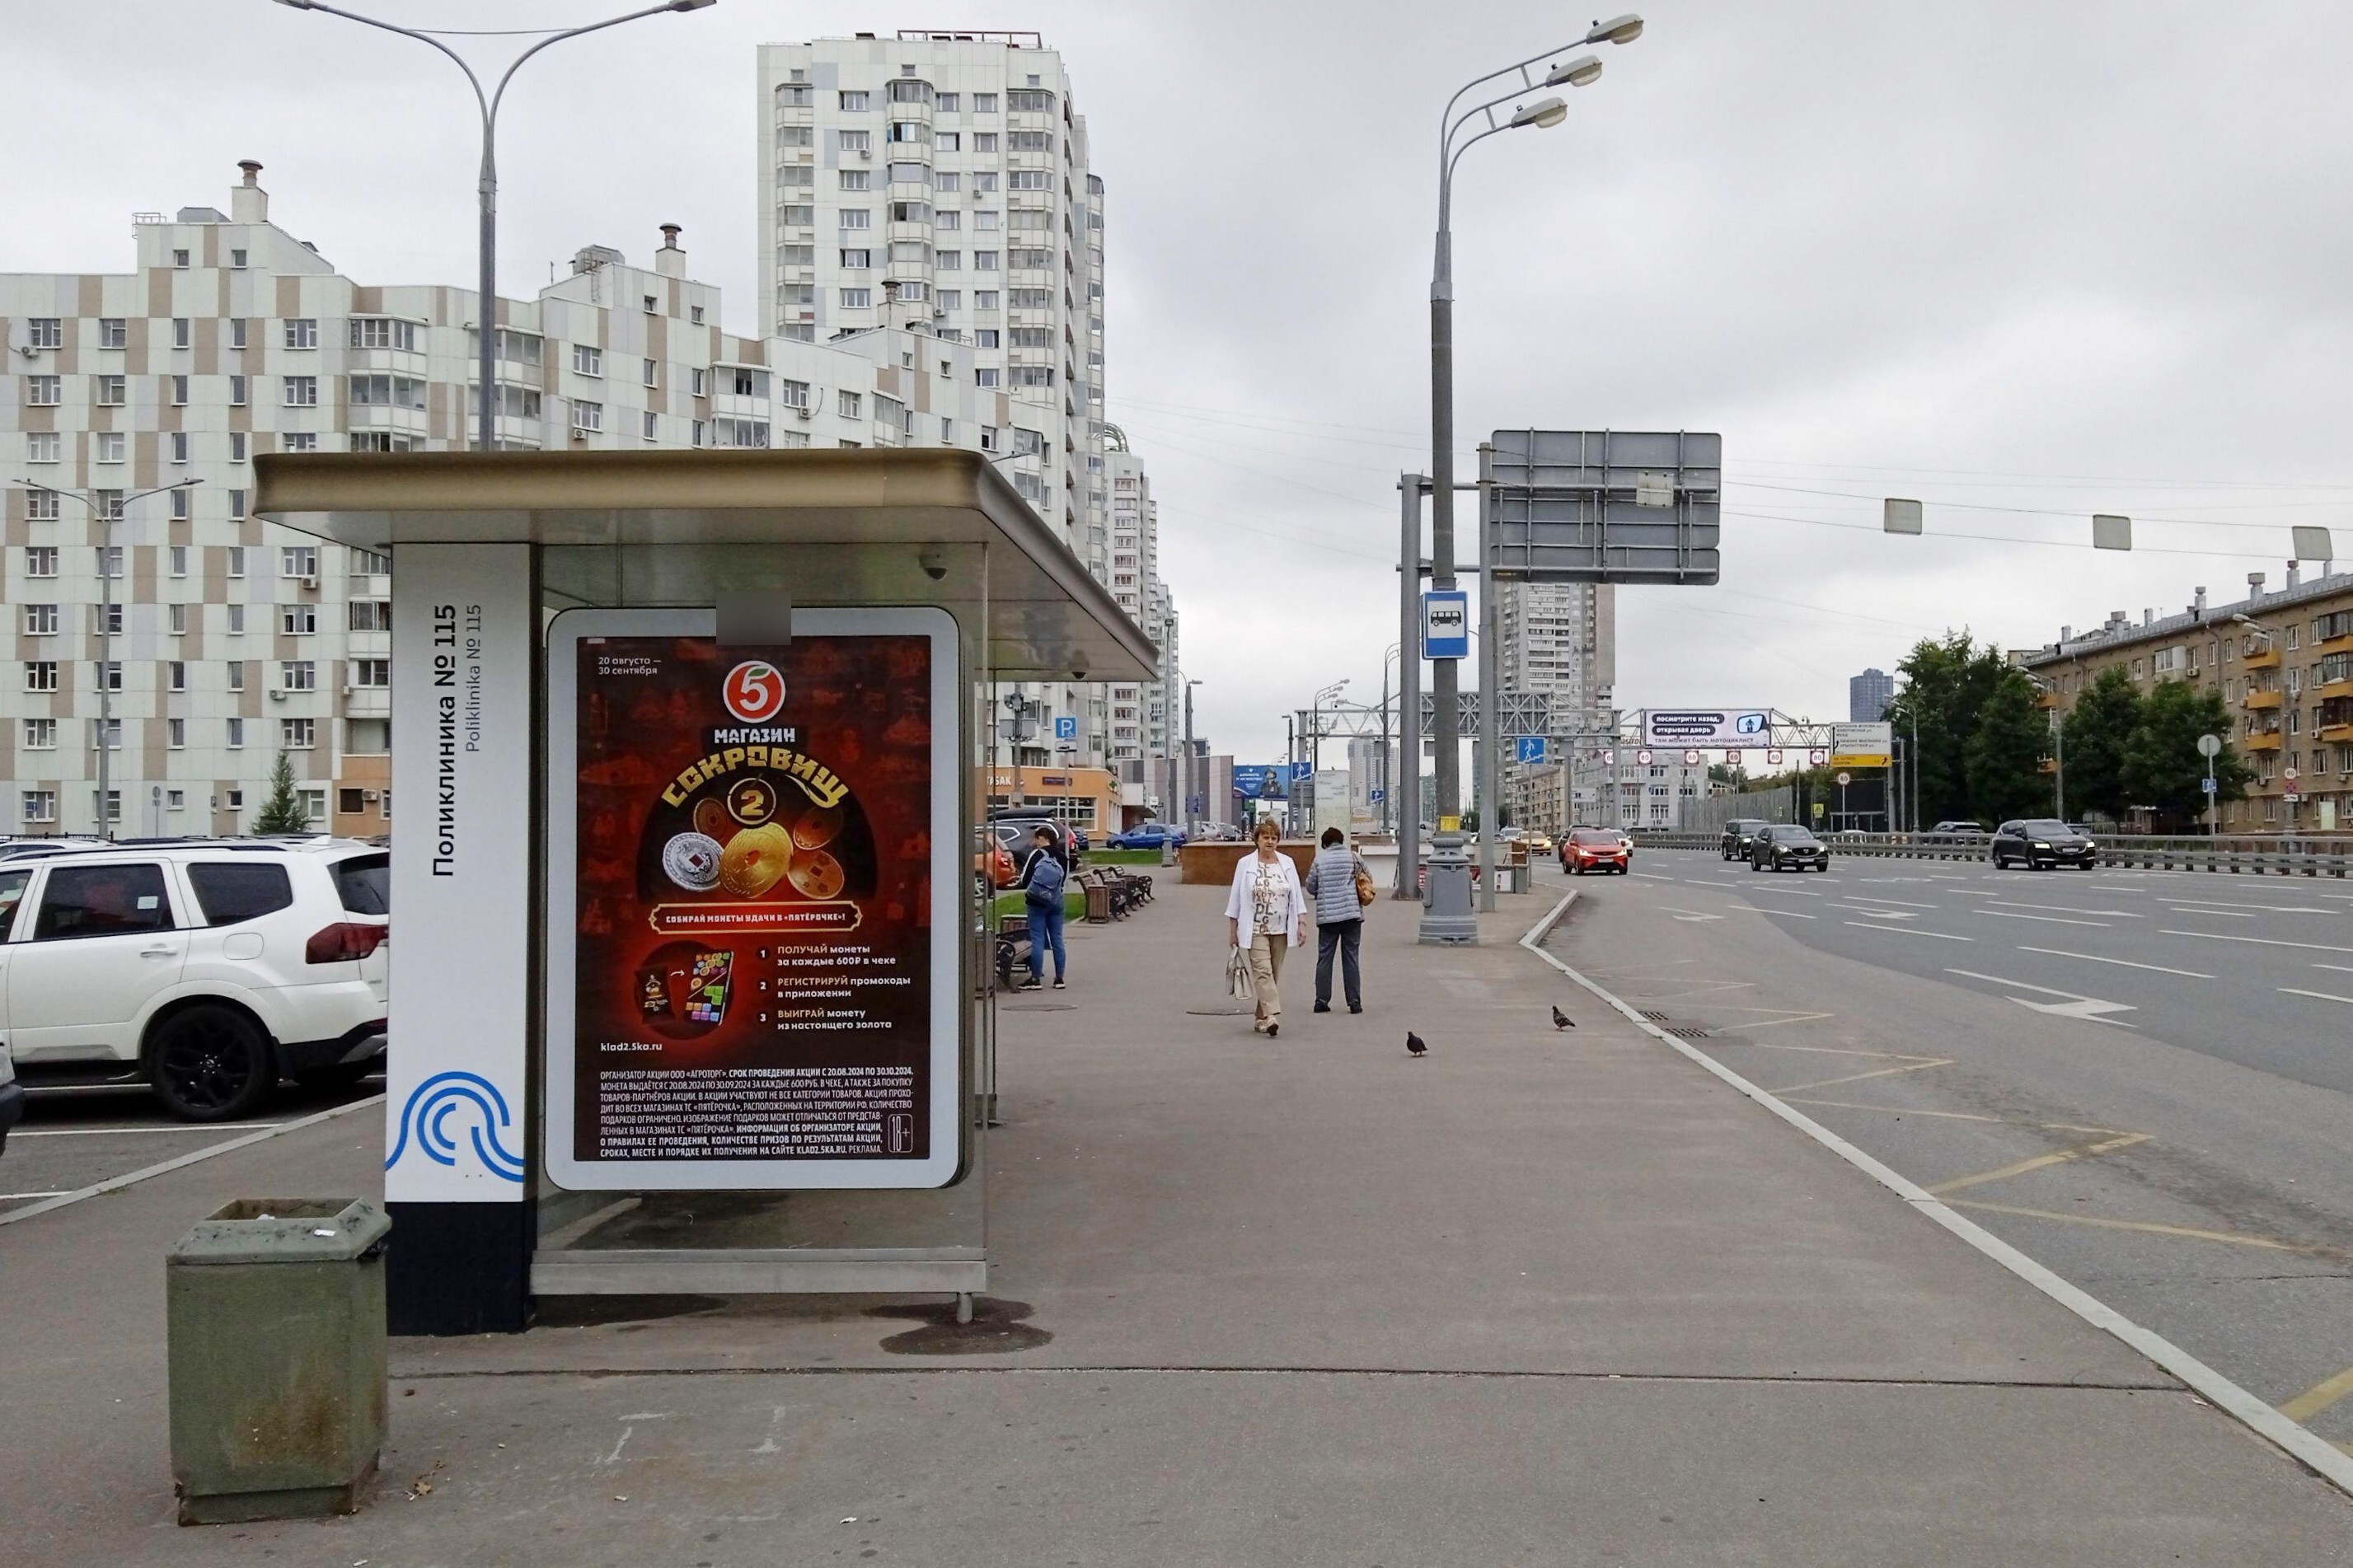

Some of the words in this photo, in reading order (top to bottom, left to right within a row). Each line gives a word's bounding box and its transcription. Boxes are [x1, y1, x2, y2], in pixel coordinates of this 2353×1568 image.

[466, 605, 481, 632] 115
[434, 605, 456, 647] 115
[466, 638, 480, 658] №
[598, 657, 610, 665] 20
[612, 658, 650, 667] августа
[434, 654, 456, 686] №
[598, 667, 610, 675] 30
[612, 666, 658, 676] сентября
[466, 665, 480, 751] Poliklinika
[714, 728, 795, 743] МАГАЗИН
[661, 746, 849, 808] СОКРОВИЩ
[433, 695, 456, 877] Поликлиника
[740, 789, 765, 816] 2
[666, 914, 705, 923] СОБИРАЙ
[707, 915, 743, 923] МОНЕТЫ
[745, 915, 776, 923] УДАЧИ
[760, 949, 766, 958] 1
[777, 943, 827, 954] ПОЛУЧАЙ
[829, 945, 870, 953] монеты
[792, 957, 834, 967] каждые
[760, 981, 766, 990] 2
[777, 975, 848, 986] РЕГИСТРИРУЙ
[851, 977, 911, 987] промокоды
[785, 990, 851, 999] приложении
[760, 1013, 766, 1022] 3
[777, 1008, 824, 1018] ВЫИГРАЙ
[827, 1009, 866, 1018] монету
[791, 1022, 854, 1030] настоящего
[855, 1021, 892, 1029] золота
[600, 1042, 663, 1051] klad2.5ka.ru
[601, 1070, 645, 1079] ОРГАНИЗАТОР
[647, 1070, 669, 1079] АКЦИИ
[670, 1070, 685, 1079] ООО
[729, 1070, 747, 1078] СРОК
[748, 1069, 794, 1078] ПРОВЕДЕНИЯ
[797, 1068, 820, 1077] АКЦИИ
[827, 1068, 864, 1076] 20.08.2024
[601, 1082, 627, 1091] МОНЕТА
[629, 1080, 663, 1090] ВЫДАЁТСЯ
[669, 1081, 705, 1089] 20.08.2024
[716, 1080, 751, 1089] 30.09.2024
[762, 1079, 790, 1088] КАЖДЫЕ
[850, 1079, 870, 1087] ТАКЖЕ
[882, 1078, 912, 1087] ПОКУПКУ
[601, 1092, 671, 1102] ТОВАРОВ-ПАРТНЁРОВ
[705, 1092, 728, 1100] АКЦИИ
[729, 1092, 767, 1100] УЧАСТВУЮТ
[780, 1091, 791, 1099] ВСЕ
[793, 1091, 830, 1099] КАТЕГОРИИ
[889, 1089, 914, 1098] ПРОХО-
[601, 1105, 613, 1113] ДИТ
[626, 1104, 642, 1112] ВСЕХ
[644, 1103, 683, 1112] МАГАЗИНАХ
[743, 1102, 802, 1111] РАСПОЛОЖЕННЫХ
[814, 1101, 855, 1110] ТЕРРИТОРИИ
[869, 1101, 912, 1109] КОЛИЧЕСТВО
[601, 1116, 636, 1124] ПОДАРКОВ
[683, 1114, 731, 1123] ИЗОБРАЖЕНИЕ
[734, 1113, 768, 1122] ПОДАРКОВ
[771, 1113, 794, 1121] МОЖЕТ
[795, 1112, 836, 1121] ОТЛИЧАТЬСЯ
[847, 1112, 883, 1121] ПРЕДСТАВ-
[601, 1126, 628, 1135] ЛЕННЫХ
[636, 1126, 675, 1135] МАГАЗИНАХ
[737, 1125, 788, 1133] ИНФОРМАЦИЯ
[802, 1124, 855, 1132] ОРГАНИЗАТОРЕ
[891, 1116, 911, 1152] 18+
[607, 1137, 645, 1146] ПРАВИЛАХ
[711, 1136, 757, 1144] КОЛИЧЕСТВЕ
[761, 1135, 789, 1144] ПРИЗОВ
[804, 1135, 854, 1144] РЕЗУЛЬТАТАМ
[632, 1149, 656, 1157] МЕСТЕ
[666, 1148, 699, 1156] ПОРЯДКЕ
[714, 1147, 757, 1155] ПОЛУЧЕНИЯ
[772, 1145, 794, 1154] САЙТЕ
